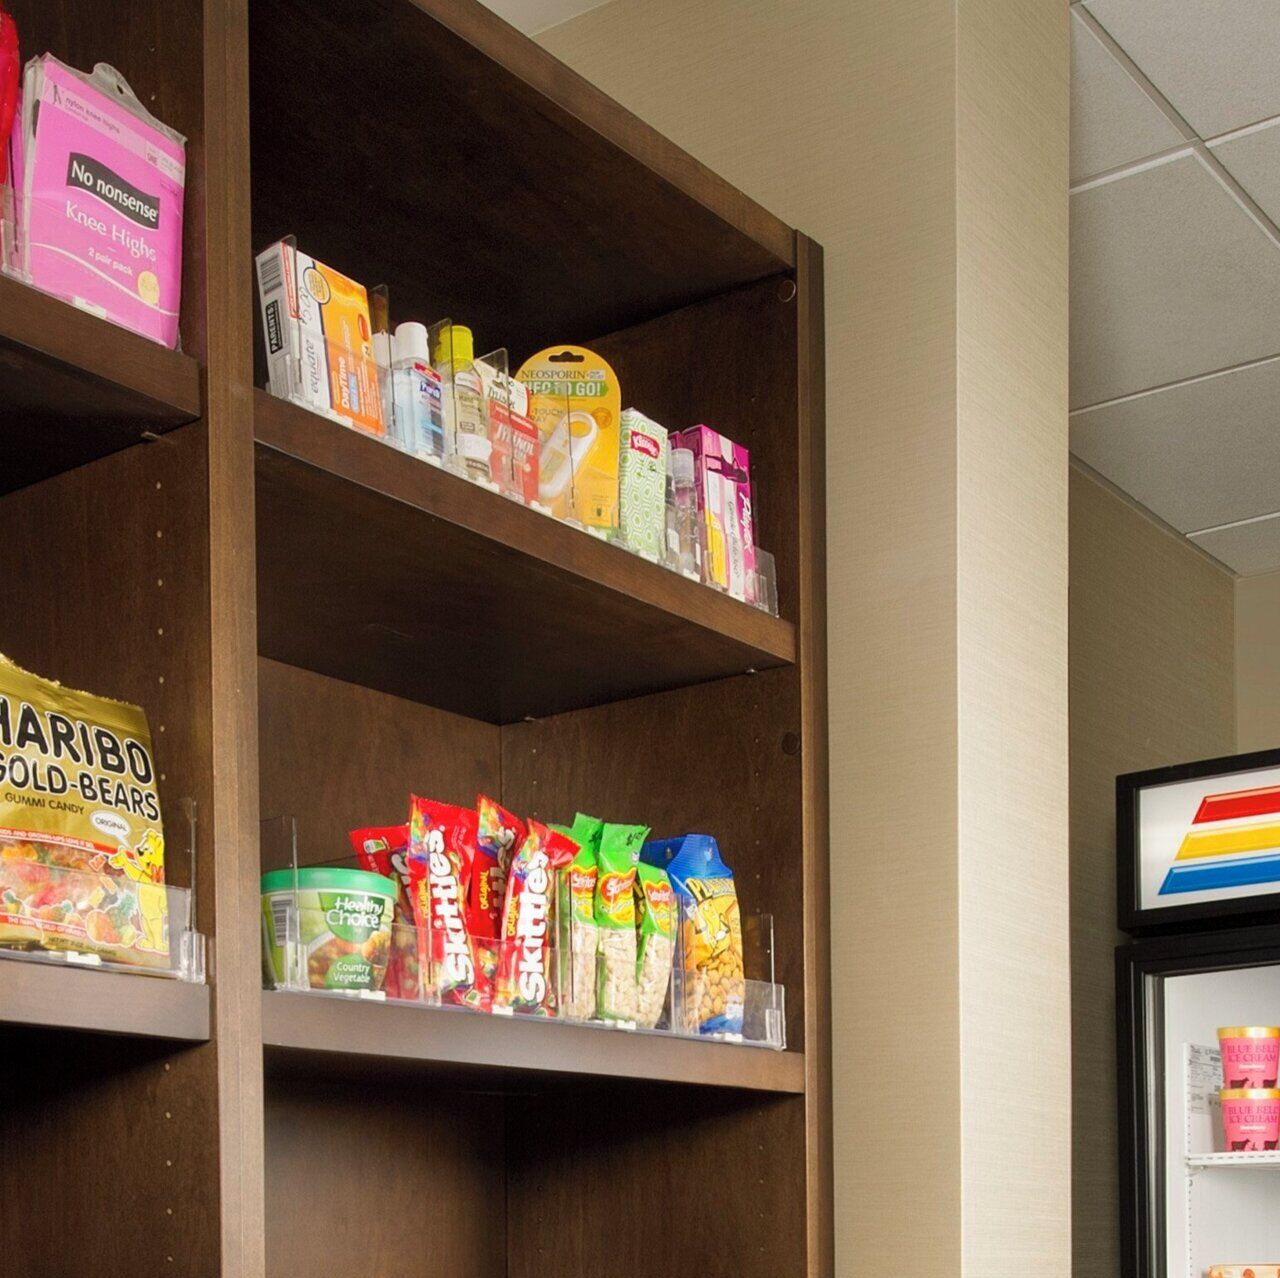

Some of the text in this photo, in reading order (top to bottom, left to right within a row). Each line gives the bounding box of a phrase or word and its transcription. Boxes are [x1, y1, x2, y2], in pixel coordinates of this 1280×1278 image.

[71, 160, 158, 223] No nonsense
[66, 200, 157, 262] Knee Highs
[87, 246, 134, 277] 2 pair pack
[338, 356, 351, 409] DayTime
[521, 369, 586, 381] NEOSPORIN
[575, 382, 602, 396] GO!
[5, 792, 85, 816] GUMMI CANDY
[95, 815, 127, 832] ORIGINAL
[479, 870, 490, 910] Original
[334, 896, 383, 919] Healthy
[426, 828, 475, 985] Skittles
[507, 895, 520, 937] Original
[326, 908, 380, 929] Choice
[519, 850, 550, 1003] Skittles
[333, 971, 371, 985] Vegetable
[336, 962, 370, 976] Country
[1243, 1053, 1277, 1063] CREAM
[1244, 1115, 1278, 1124] CREAM
